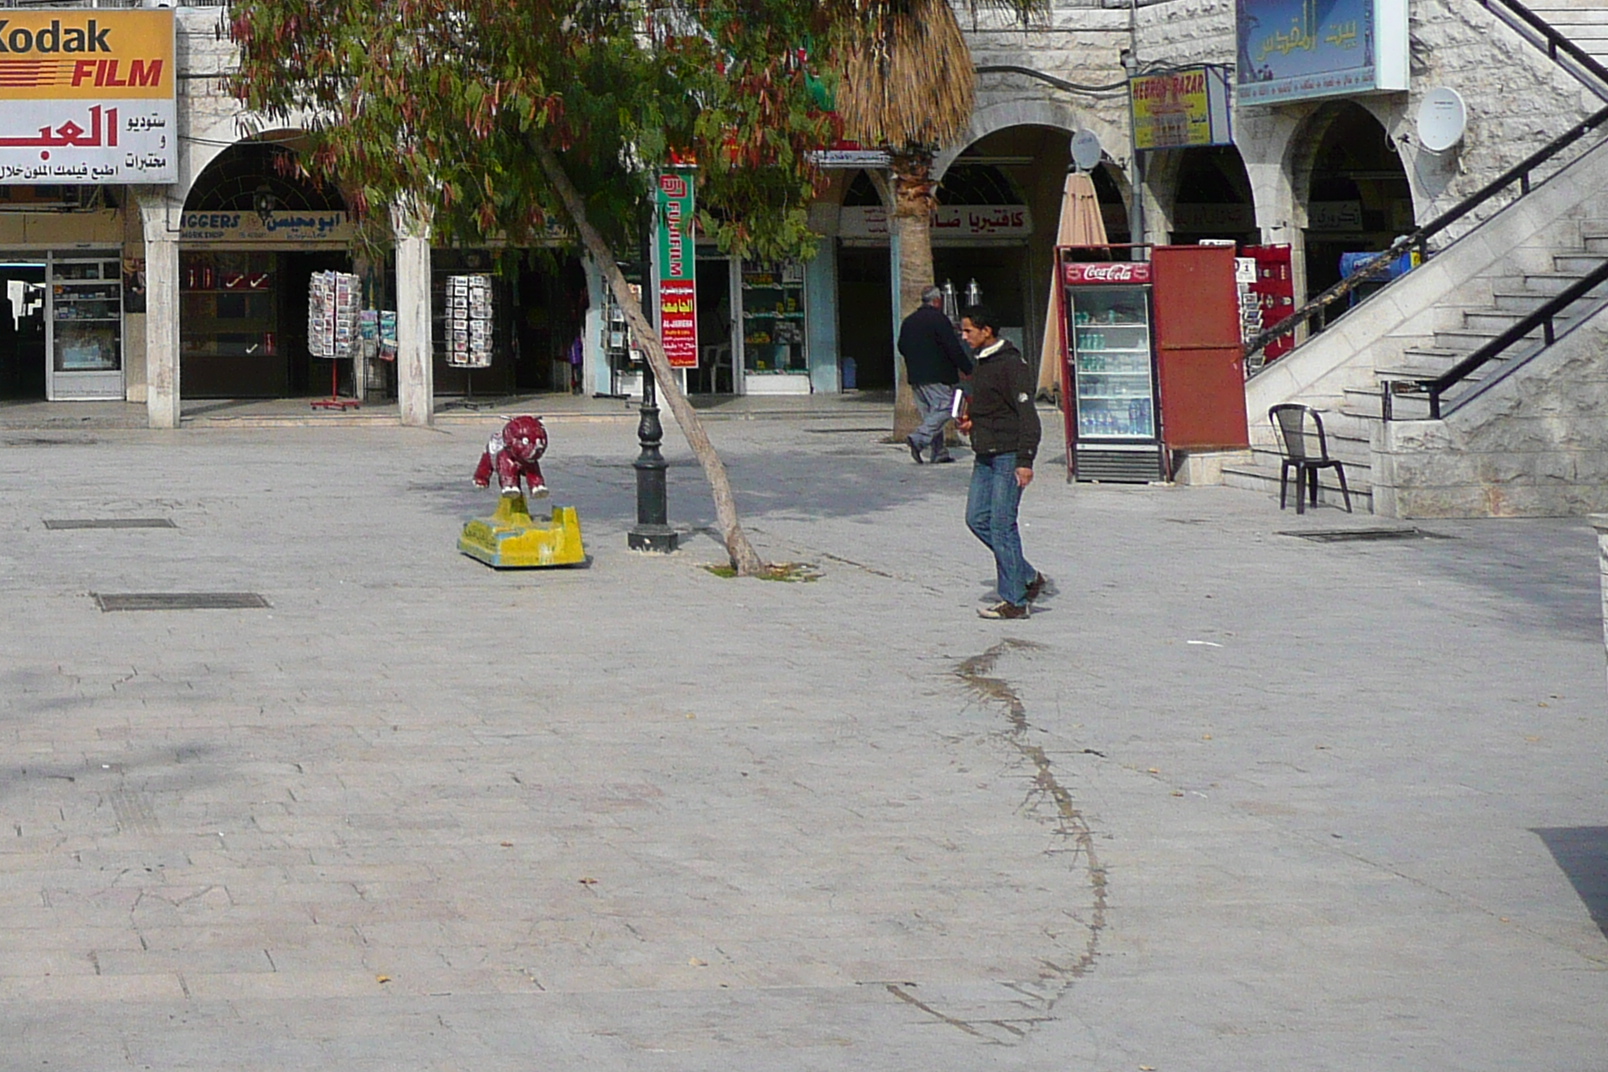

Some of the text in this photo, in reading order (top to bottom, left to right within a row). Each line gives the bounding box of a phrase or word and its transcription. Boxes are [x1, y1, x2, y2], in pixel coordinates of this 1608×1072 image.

[71, 59, 163, 87] FILM
[1173, 74, 1205, 97] BAZAR
[126, 112, 166, 132] ستوديو
[158, 135, 166, 149] و
[24, 165, 52, 179] الملون
[54, 162, 88, 177] فيلمك
[91, 164, 119, 180] اطبع
[124, 152, 167, 174] مختبرات
[968, 209, 1024, 233] كافتيريا
[667, 200, 683, 277] FUJIFILM
[1083, 265, 1132, 281] Coca-Cola
